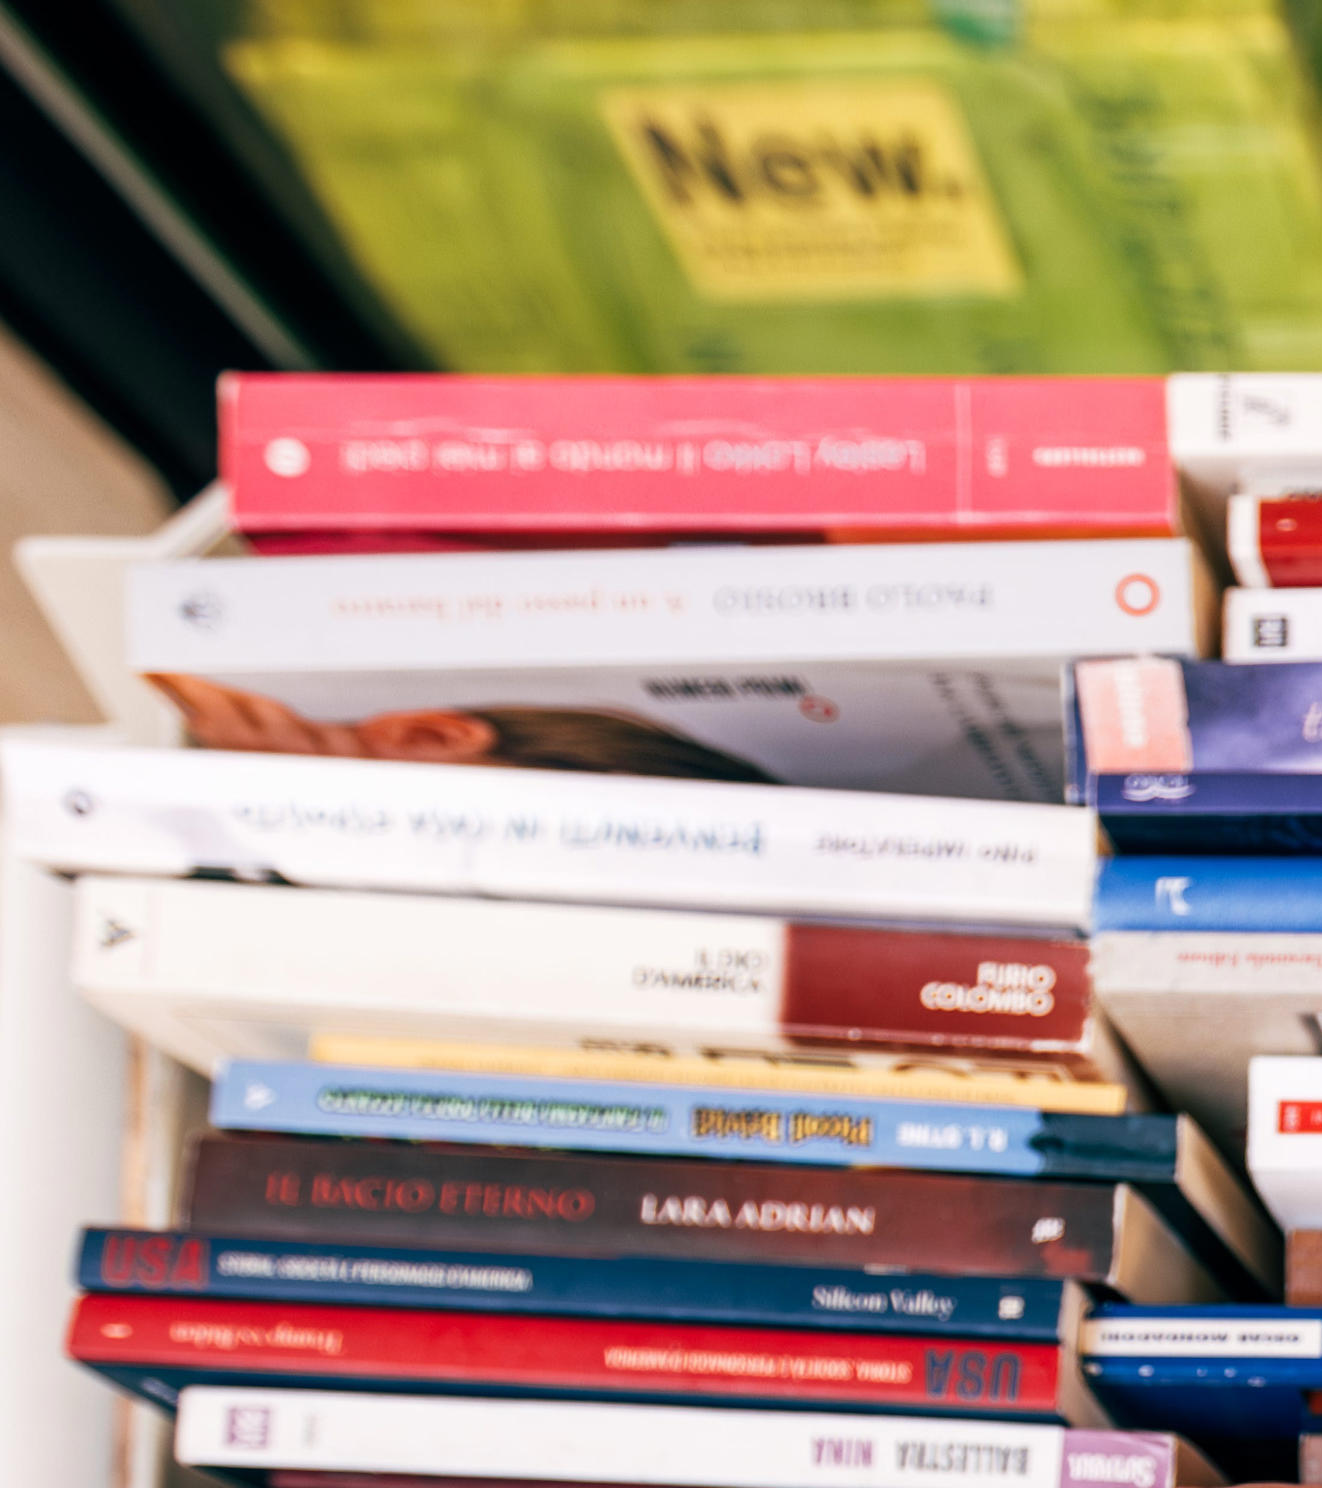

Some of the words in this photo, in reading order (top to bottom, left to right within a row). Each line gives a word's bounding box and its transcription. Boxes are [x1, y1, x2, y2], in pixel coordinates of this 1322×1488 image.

[264, 1171, 297, 1206] IL
[308, 1171, 435, 1216] BACIO
[640, 1193, 732, 1230] LARA
[734, 1198, 878, 1237] ADRIAN
[97, 1232, 209, 1291] USA
[923, 1350, 1023, 1403] USA
